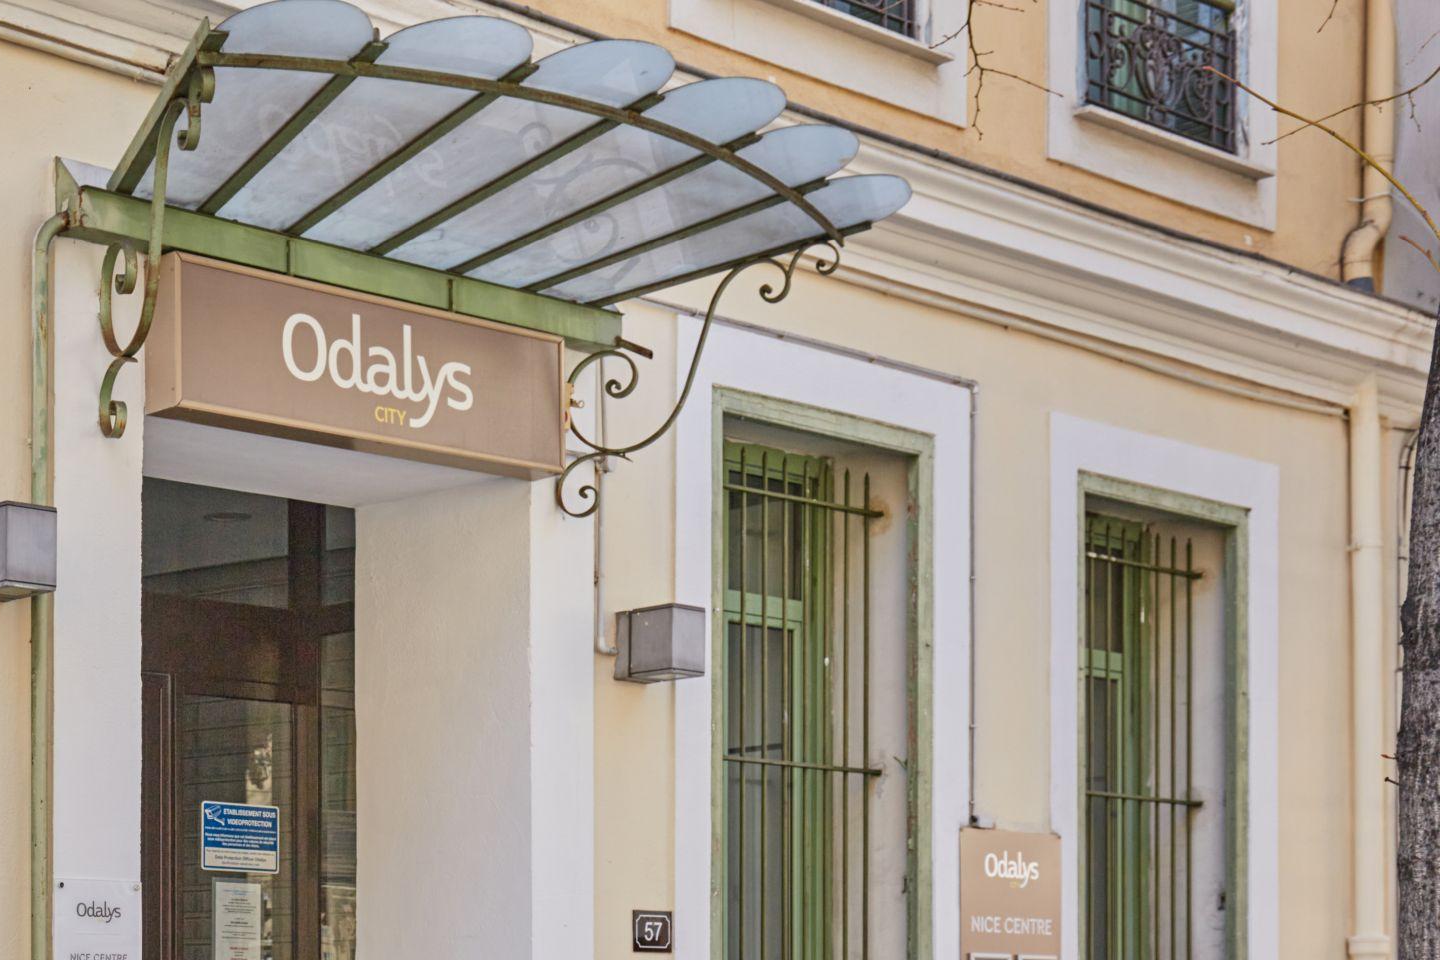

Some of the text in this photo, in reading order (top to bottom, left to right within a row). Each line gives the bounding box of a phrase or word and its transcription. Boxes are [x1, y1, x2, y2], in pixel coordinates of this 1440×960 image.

[281, 312, 474, 429] Odalys
[374, 404, 406, 427] CITY
[262, 811, 276, 819] SOUS
[984, 850, 1040, 889] Odalys
[76, 900, 122, 924] Odalys
[644, 921, 663, 942] 57
[970, 915, 1053, 936] NICE CENTRE
